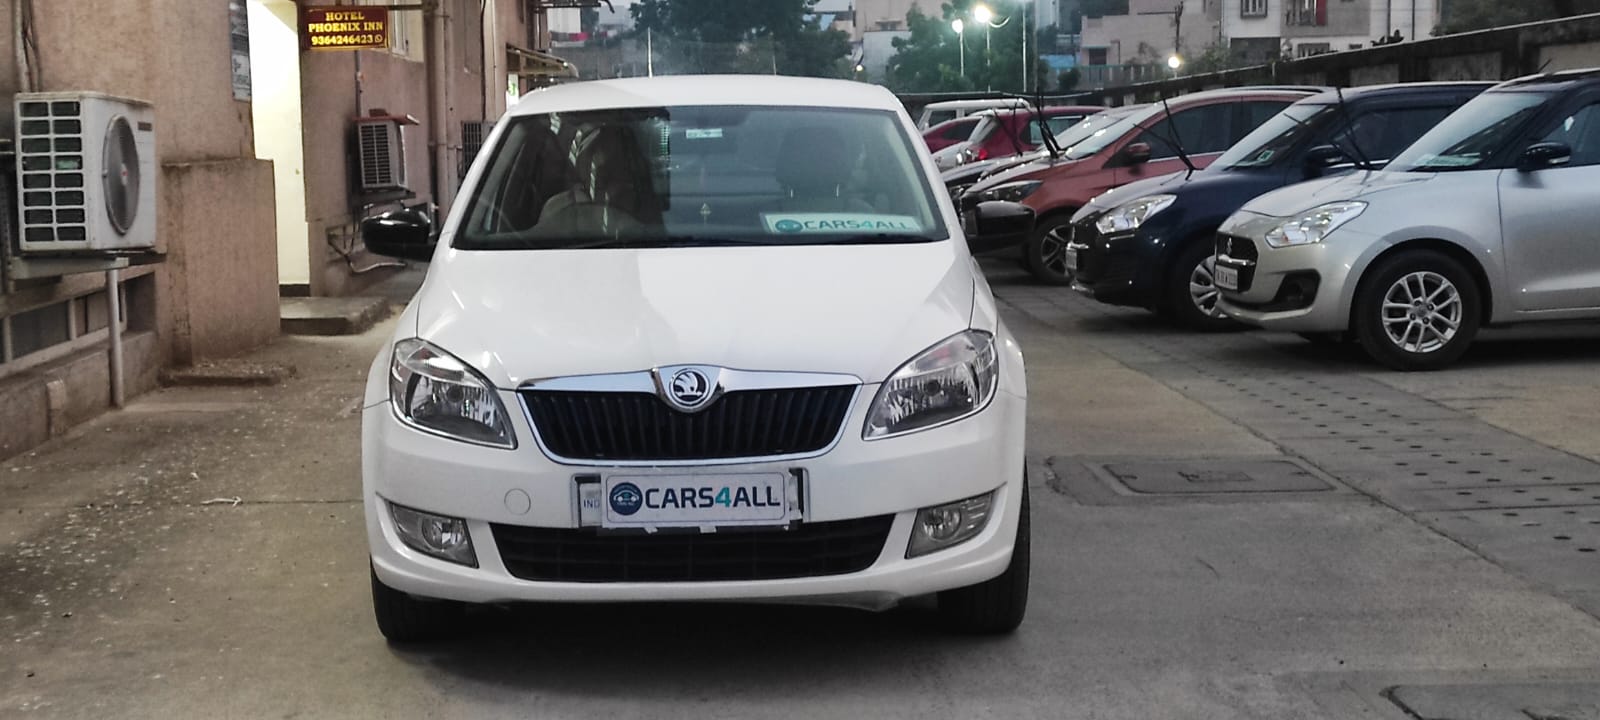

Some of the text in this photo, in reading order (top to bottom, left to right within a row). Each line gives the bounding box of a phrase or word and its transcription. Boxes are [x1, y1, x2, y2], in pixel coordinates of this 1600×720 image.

[325, 12, 365, 21] HOTEL
[308, 21, 383, 33] PHOENIX INN
[311, 34, 373, 46] 9364246423
[803, 219, 914, 230] CARS4ALL
[645, 486, 781, 509] CARS4ALL
[583, 499, 600, 508] IND
